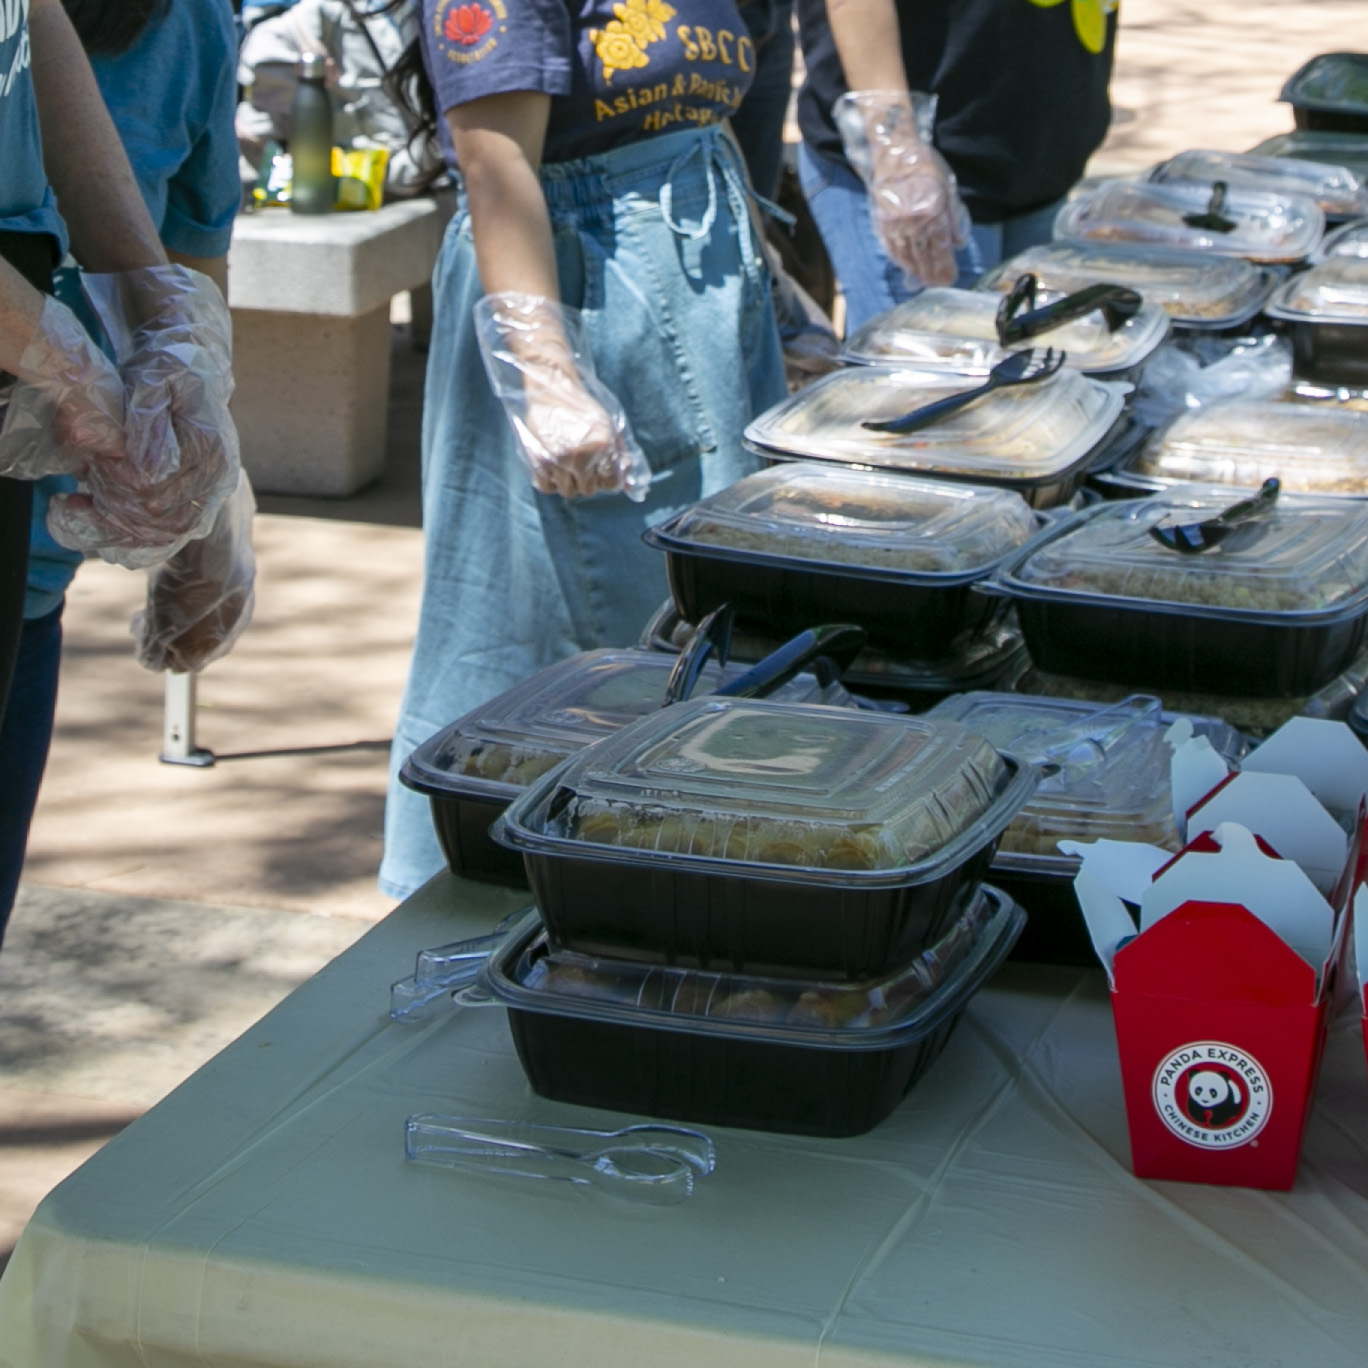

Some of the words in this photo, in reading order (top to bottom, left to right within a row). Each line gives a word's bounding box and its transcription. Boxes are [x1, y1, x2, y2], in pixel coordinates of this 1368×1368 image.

[677, 25, 751, 73] SBCC
[594, 82, 667, 122] Asian
[1160, 1050, 1203, 1086] PANDA
[1207, 1048, 1264, 1093] EXPRESS
[1164, 1104, 1209, 1141] CHINESE
[1213, 1112, 1260, 1142] KITCHEN
